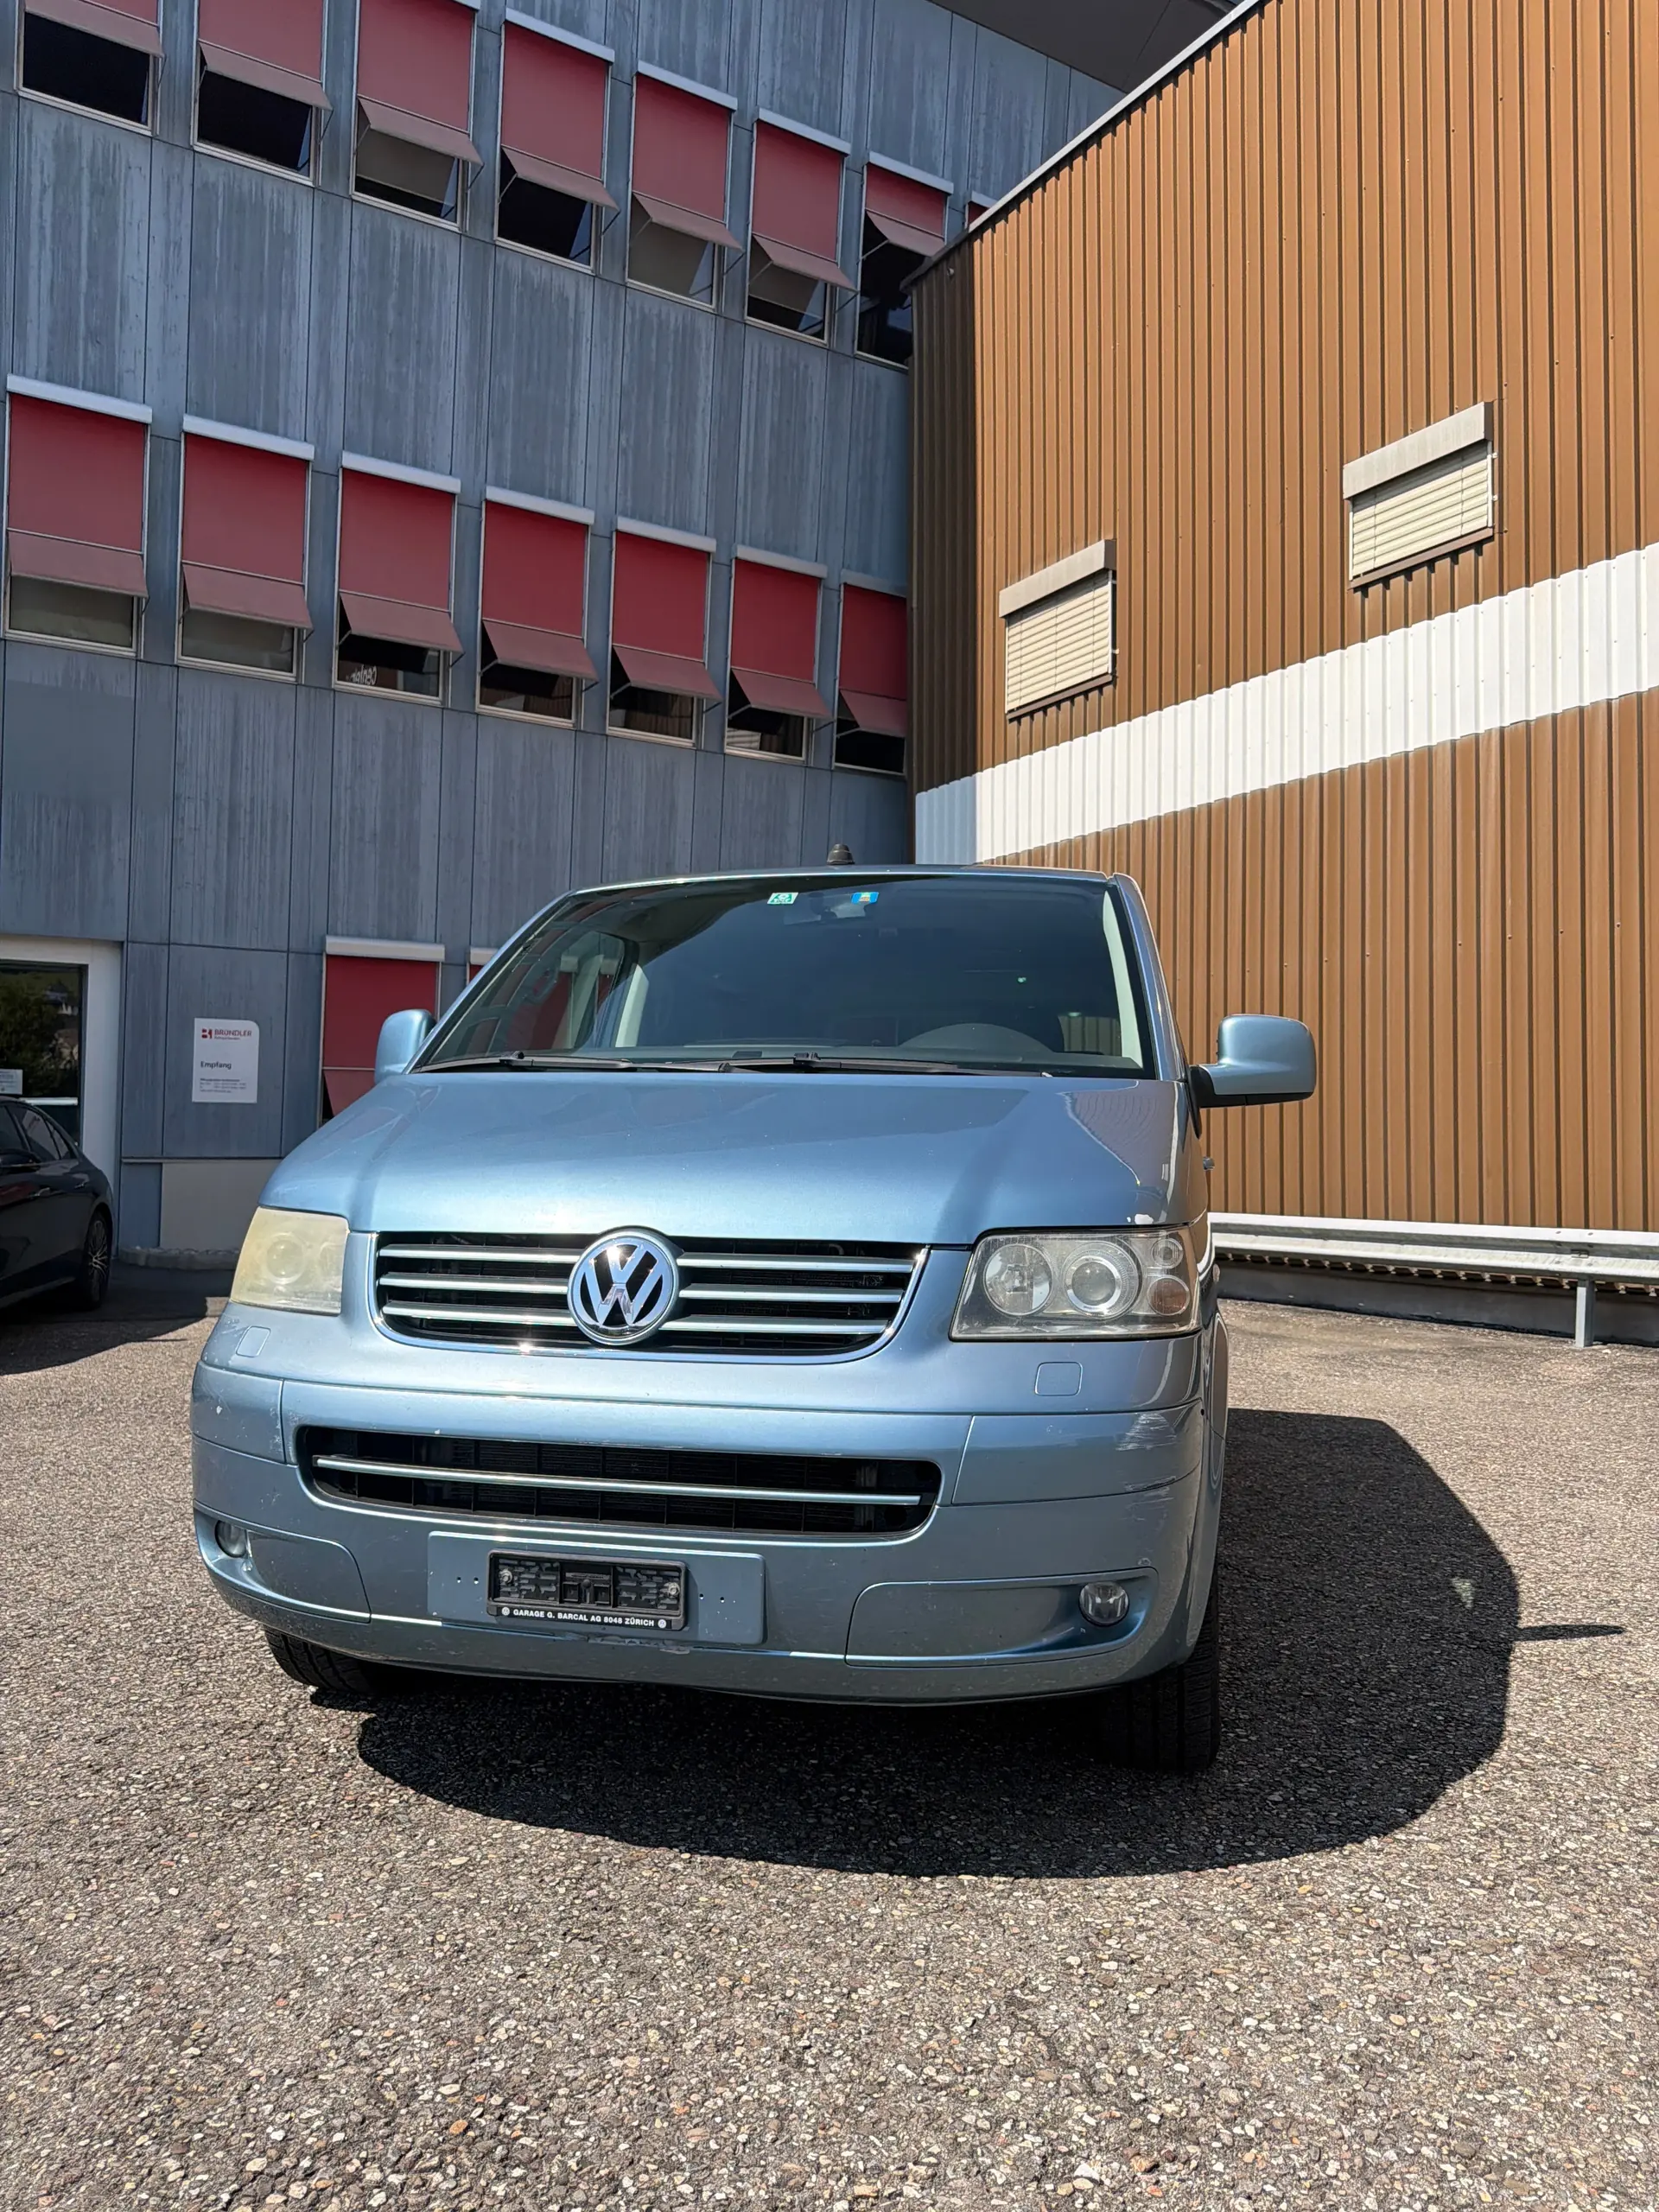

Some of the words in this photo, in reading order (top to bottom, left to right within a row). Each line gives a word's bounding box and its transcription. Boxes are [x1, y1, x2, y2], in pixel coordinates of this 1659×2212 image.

[200, 1061, 232, 1070] Empfang
[512, 1609, 545, 1618] GARAGE
[557, 1612, 588, 1621] BARCAL
[624, 1617, 654, 1626] ZÜRICH
